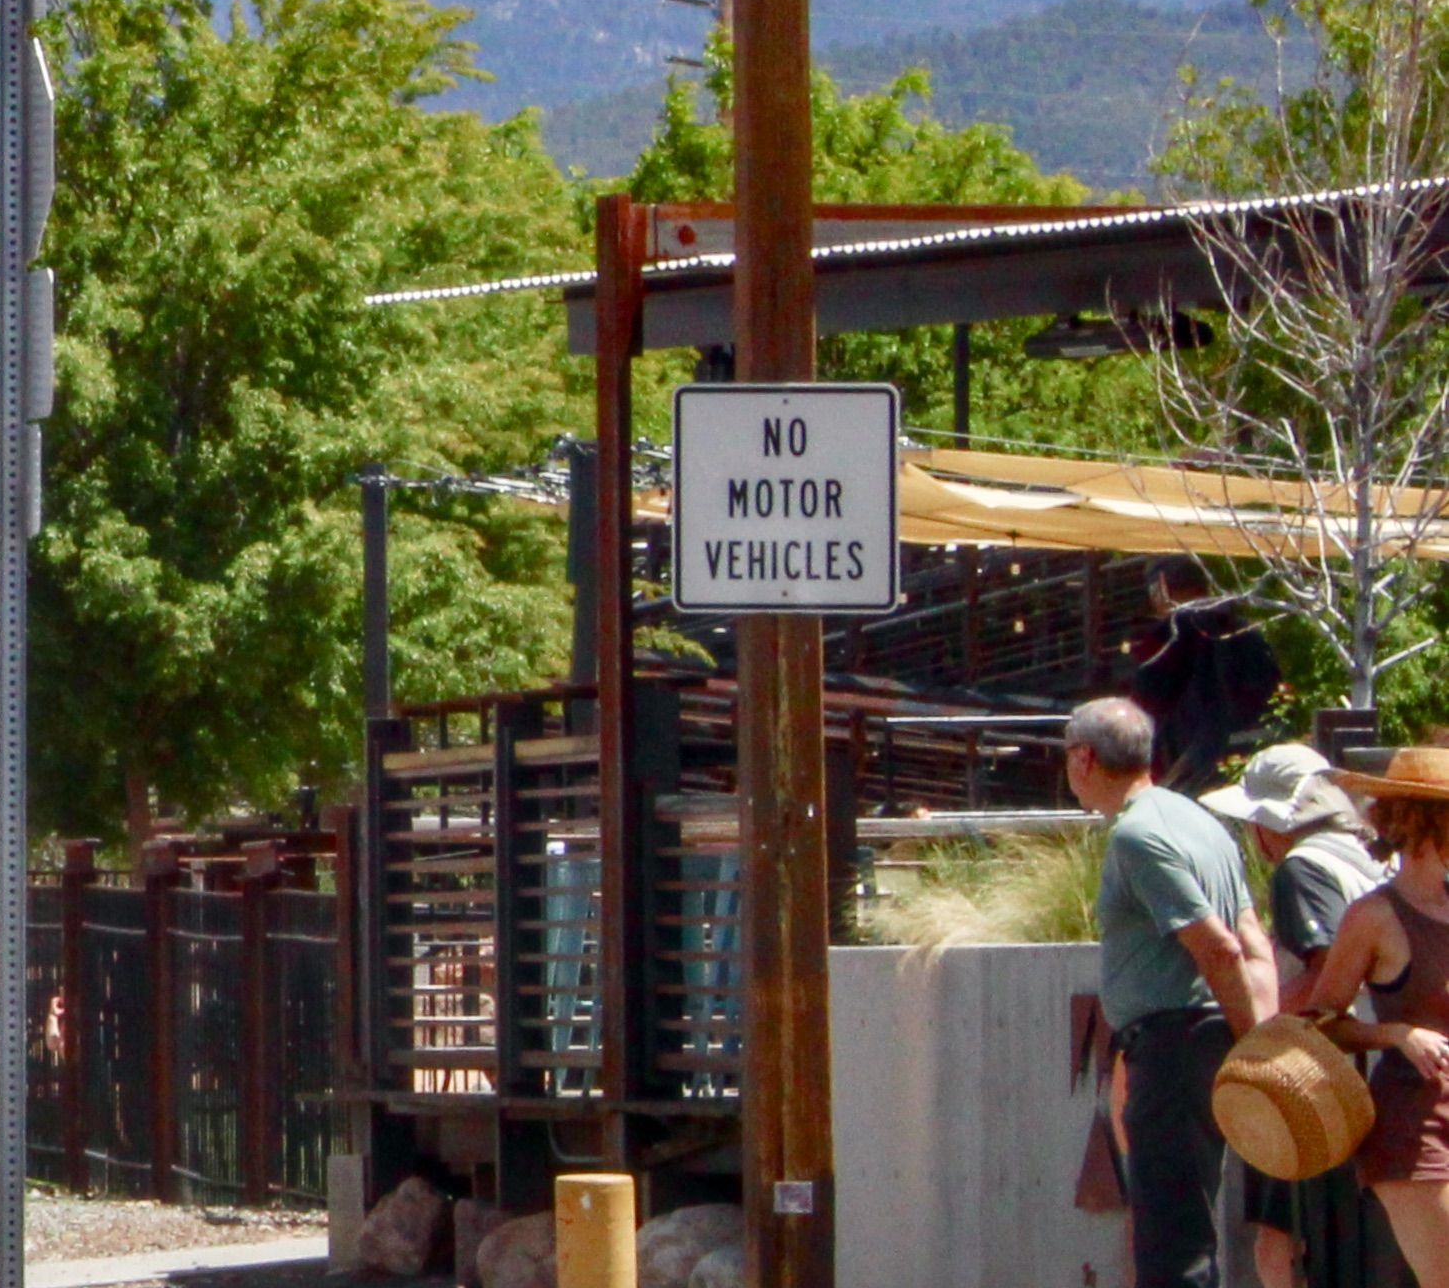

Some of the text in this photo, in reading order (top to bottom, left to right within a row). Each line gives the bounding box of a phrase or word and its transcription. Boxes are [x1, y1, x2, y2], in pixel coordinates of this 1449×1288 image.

[763, 417, 808, 457] NO
[728, 478, 843, 518] MOTOR
[704, 540, 865, 581] VEHICLES
